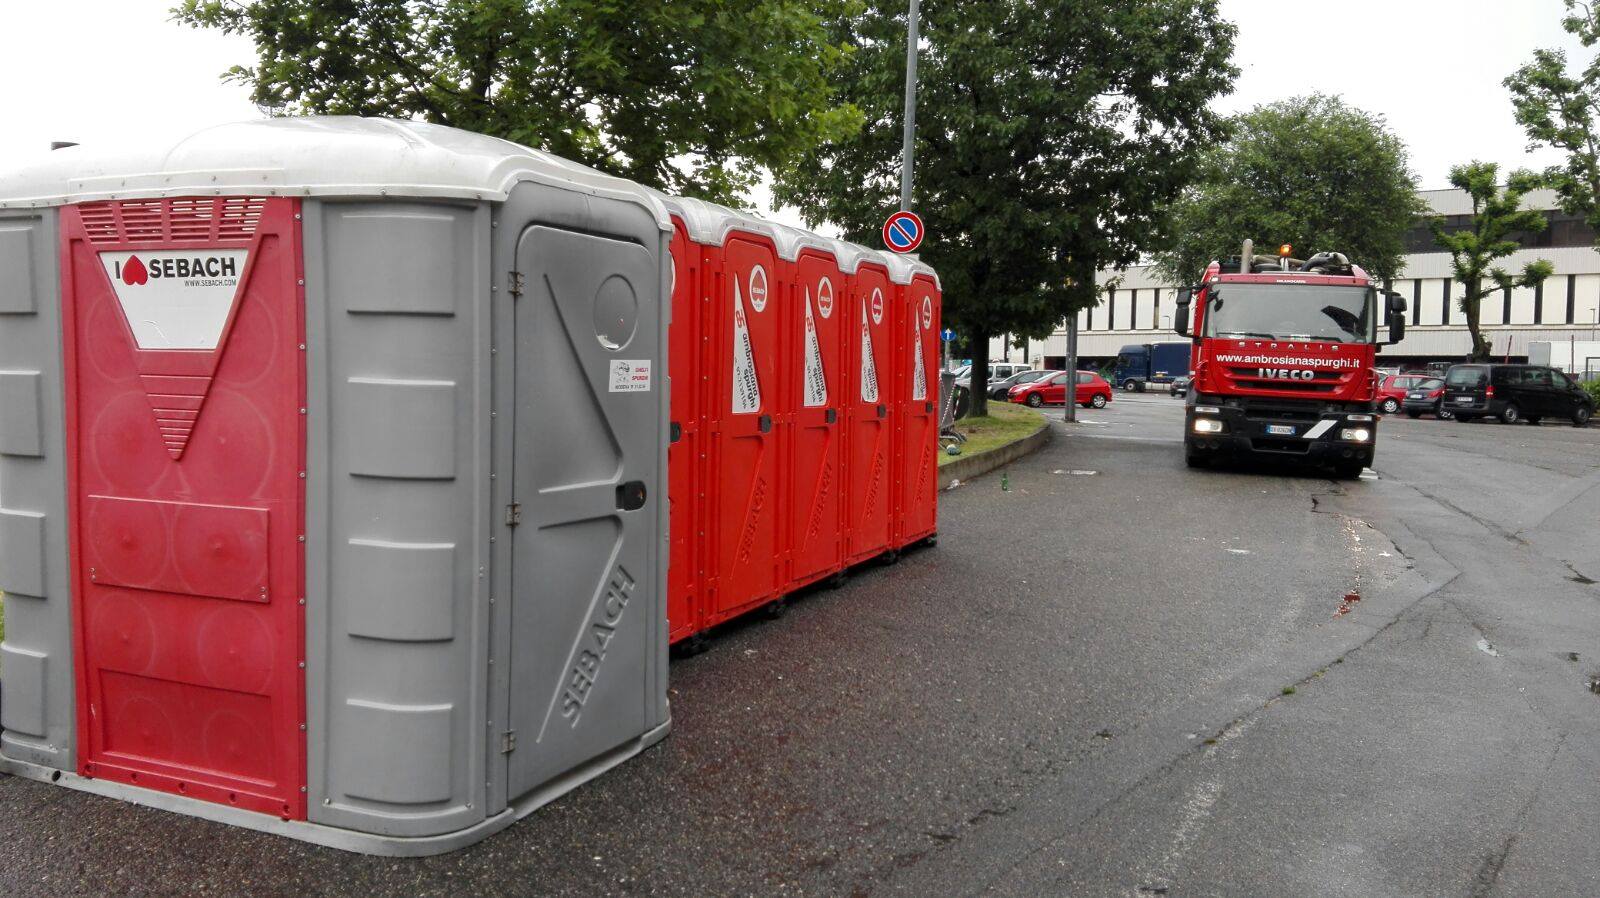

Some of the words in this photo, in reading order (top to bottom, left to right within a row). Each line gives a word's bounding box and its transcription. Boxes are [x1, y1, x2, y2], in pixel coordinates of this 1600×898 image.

[115, 261, 121, 279] I
[149, 257, 236, 279] SEBACH
[1239, 342, 1339, 351] STRALIS
[1216, 354, 1360, 369] www.ambrosianaspurghi.it
[1258, 367, 1314, 380] IVECO
[561, 564, 635, 728] SEBACH
